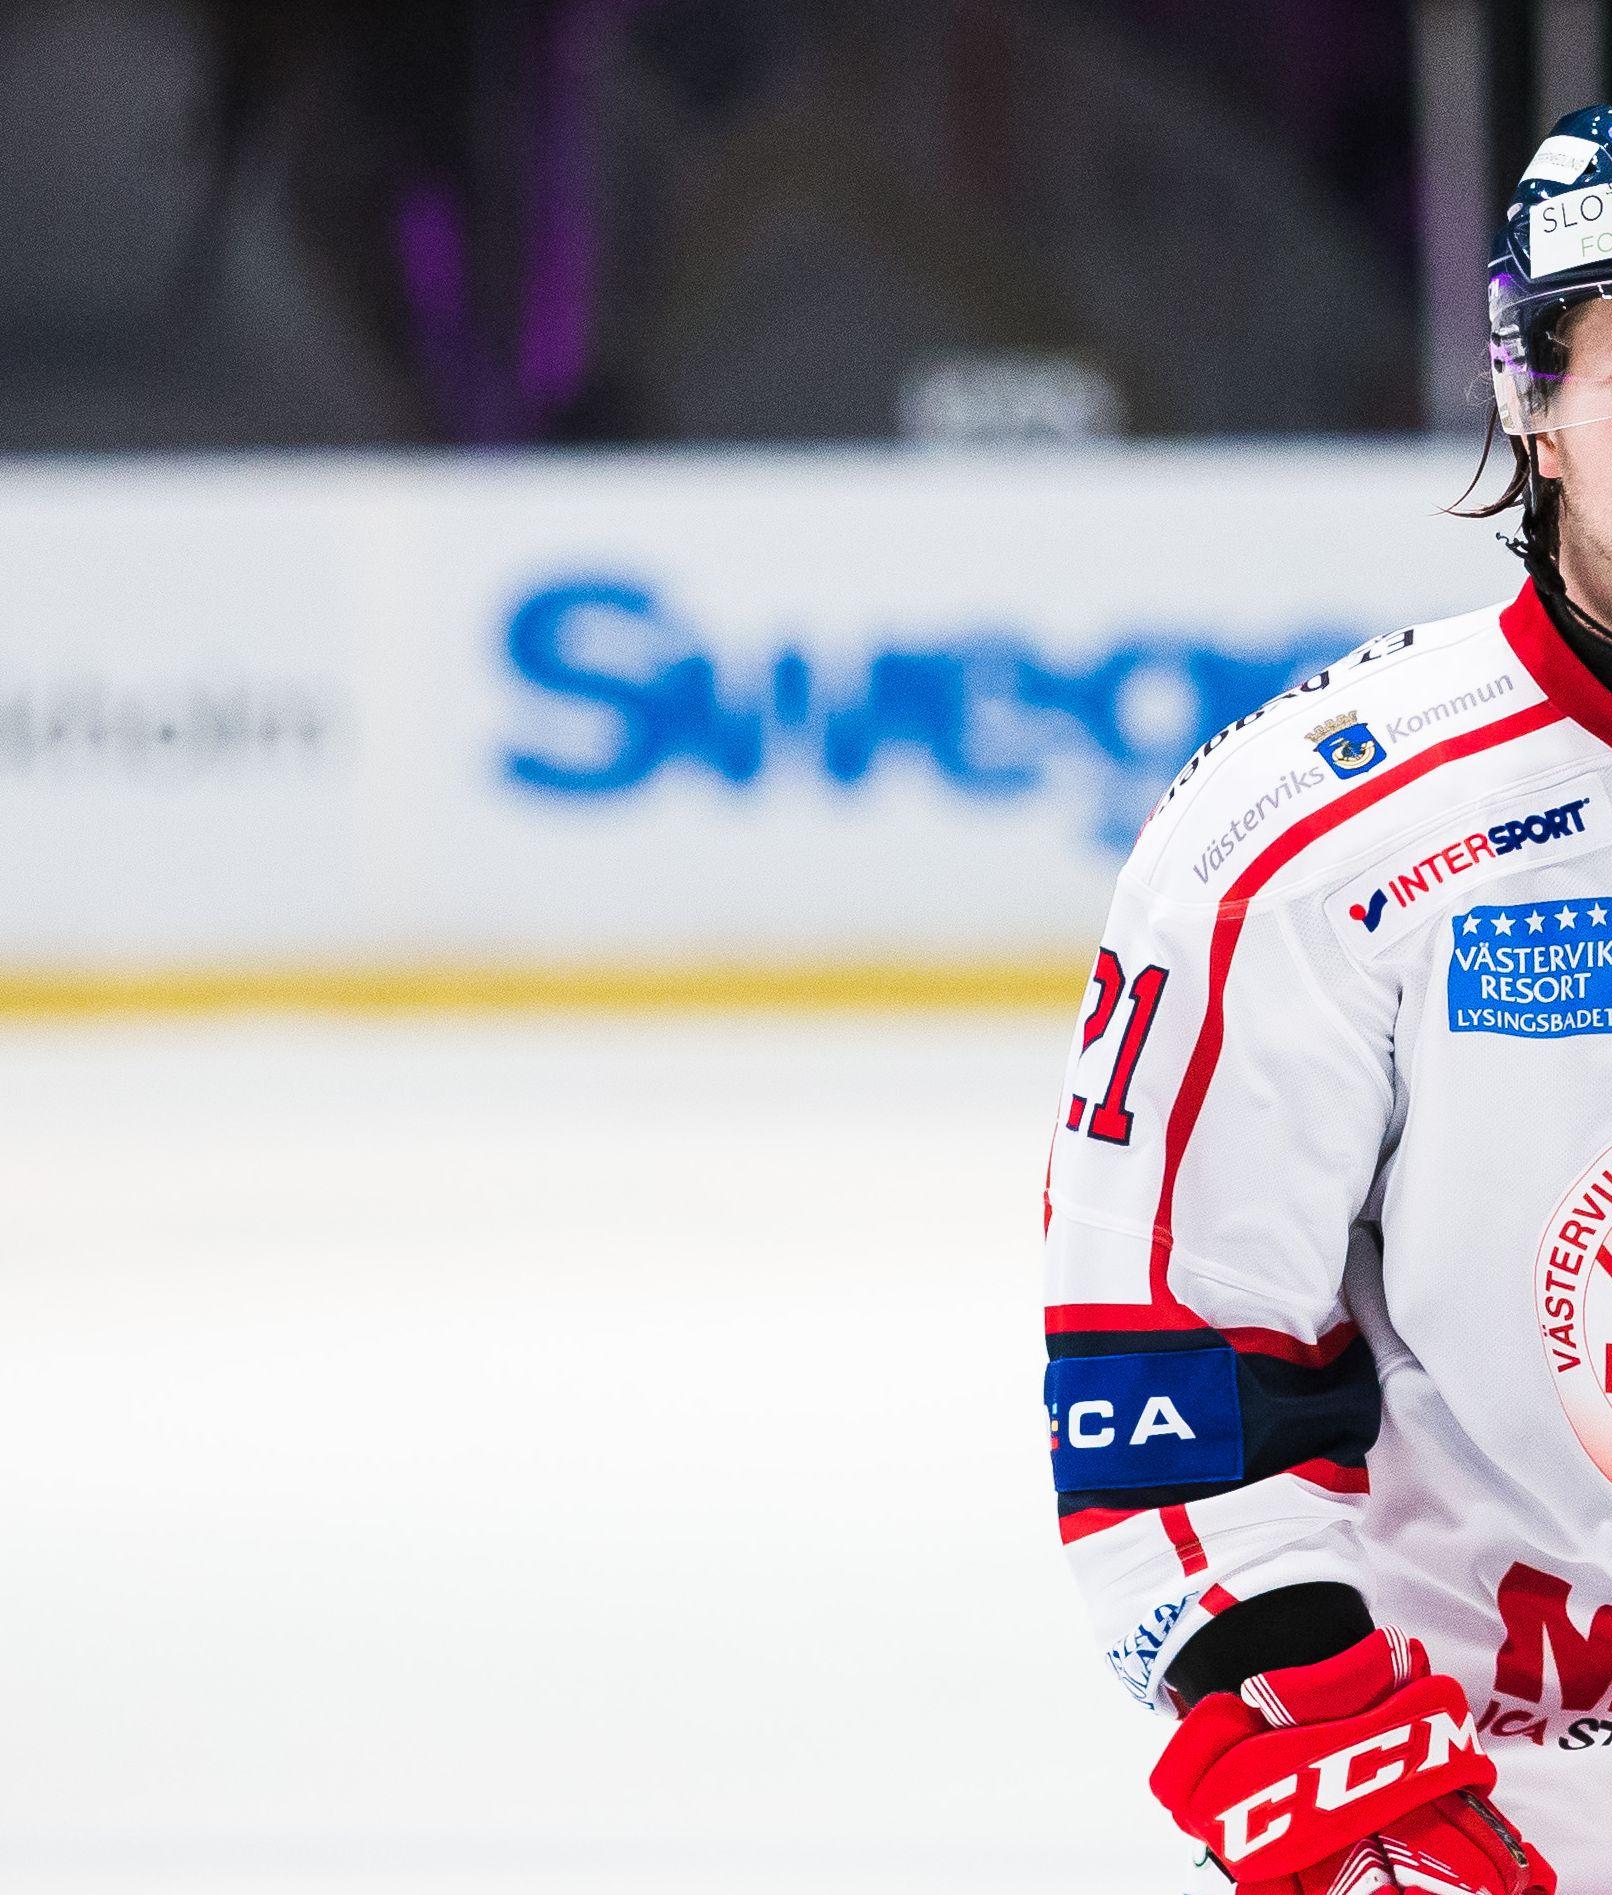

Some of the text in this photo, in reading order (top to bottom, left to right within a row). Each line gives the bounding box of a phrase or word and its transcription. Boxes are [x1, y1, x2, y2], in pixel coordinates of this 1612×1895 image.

[1192, 672, 1515, 885] Västerviks Kommun
[1388, 798, 1590, 908] INTERSPORT
[1066, 946, 1171, 1147] 21
[1480, 972, 1592, 1004] RESORT
[1214, 1711, 1488, 1863] CCM
